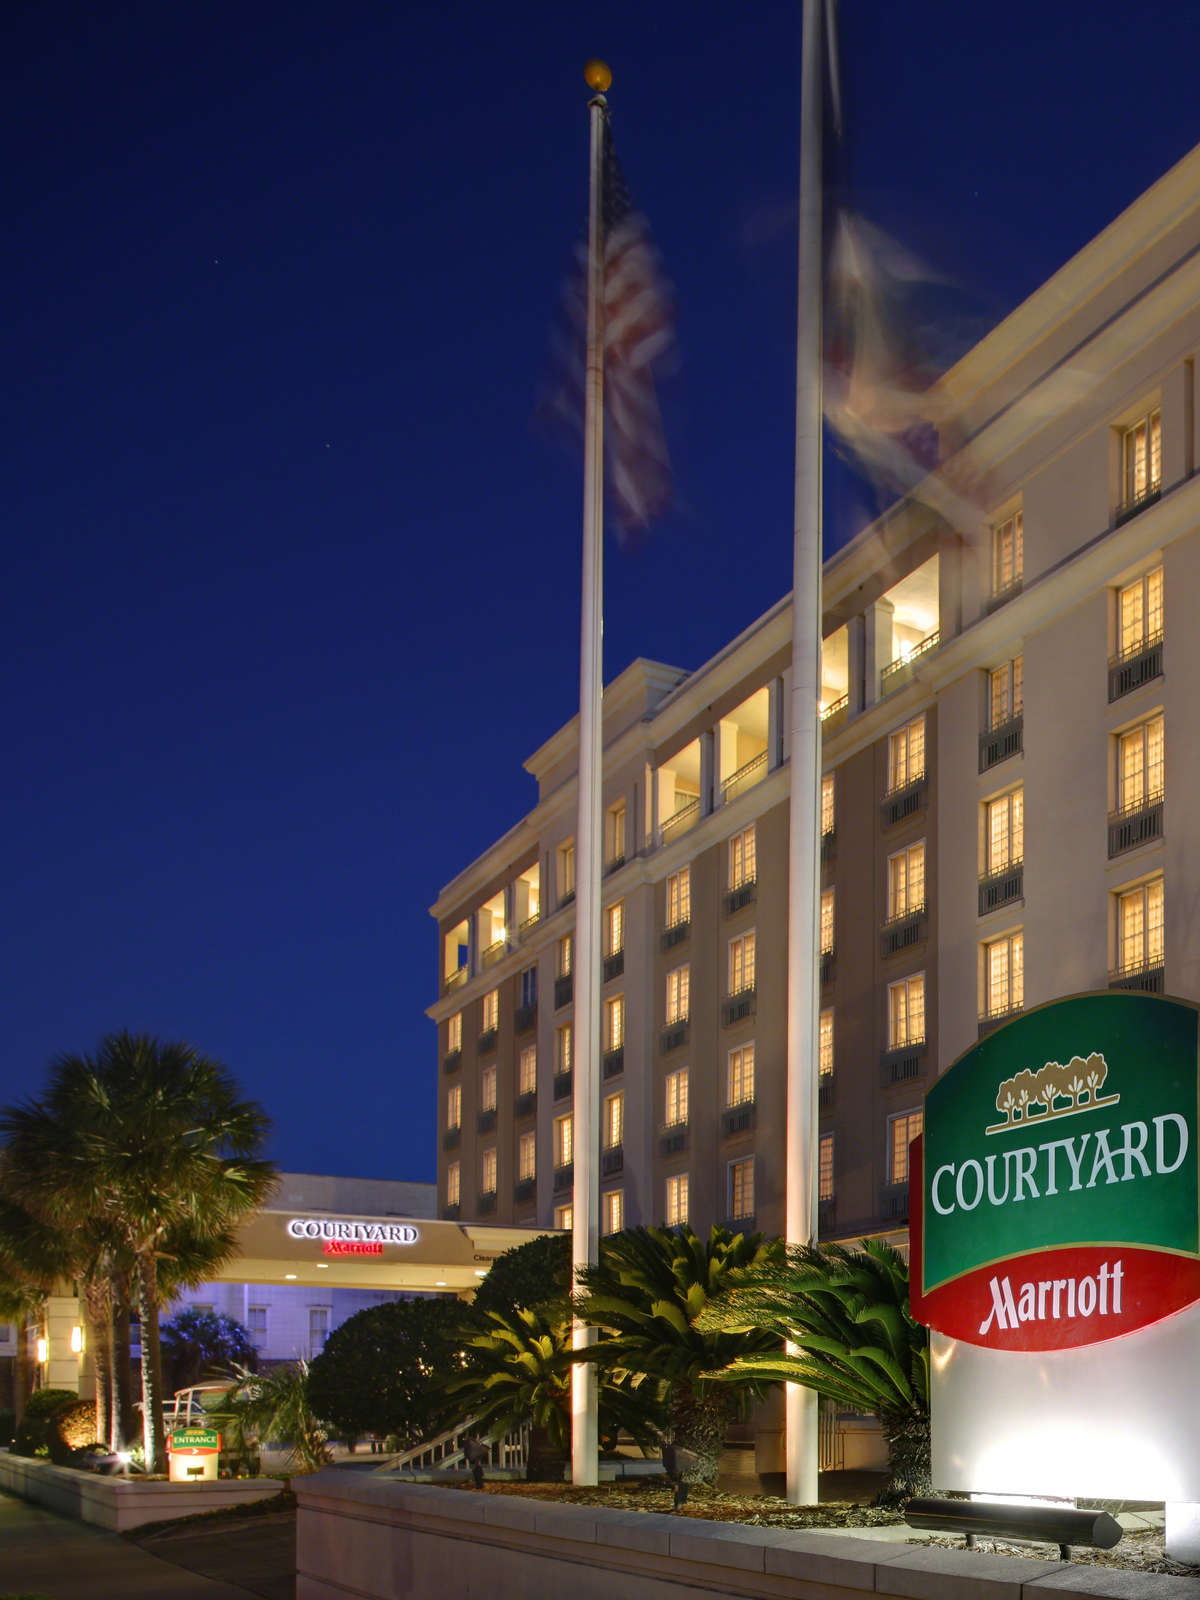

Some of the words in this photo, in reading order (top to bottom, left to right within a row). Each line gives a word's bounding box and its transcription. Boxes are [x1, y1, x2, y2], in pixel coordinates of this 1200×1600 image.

[931, 1113, 1189, 1215] COURTYARD
[288, 1219, 418, 1243] COURTYARD
[323, 1240, 384, 1255] Marriott
[978, 1260, 1124, 1335] Marriott
[173, 1436, 217, 1444] ENTRANCE
